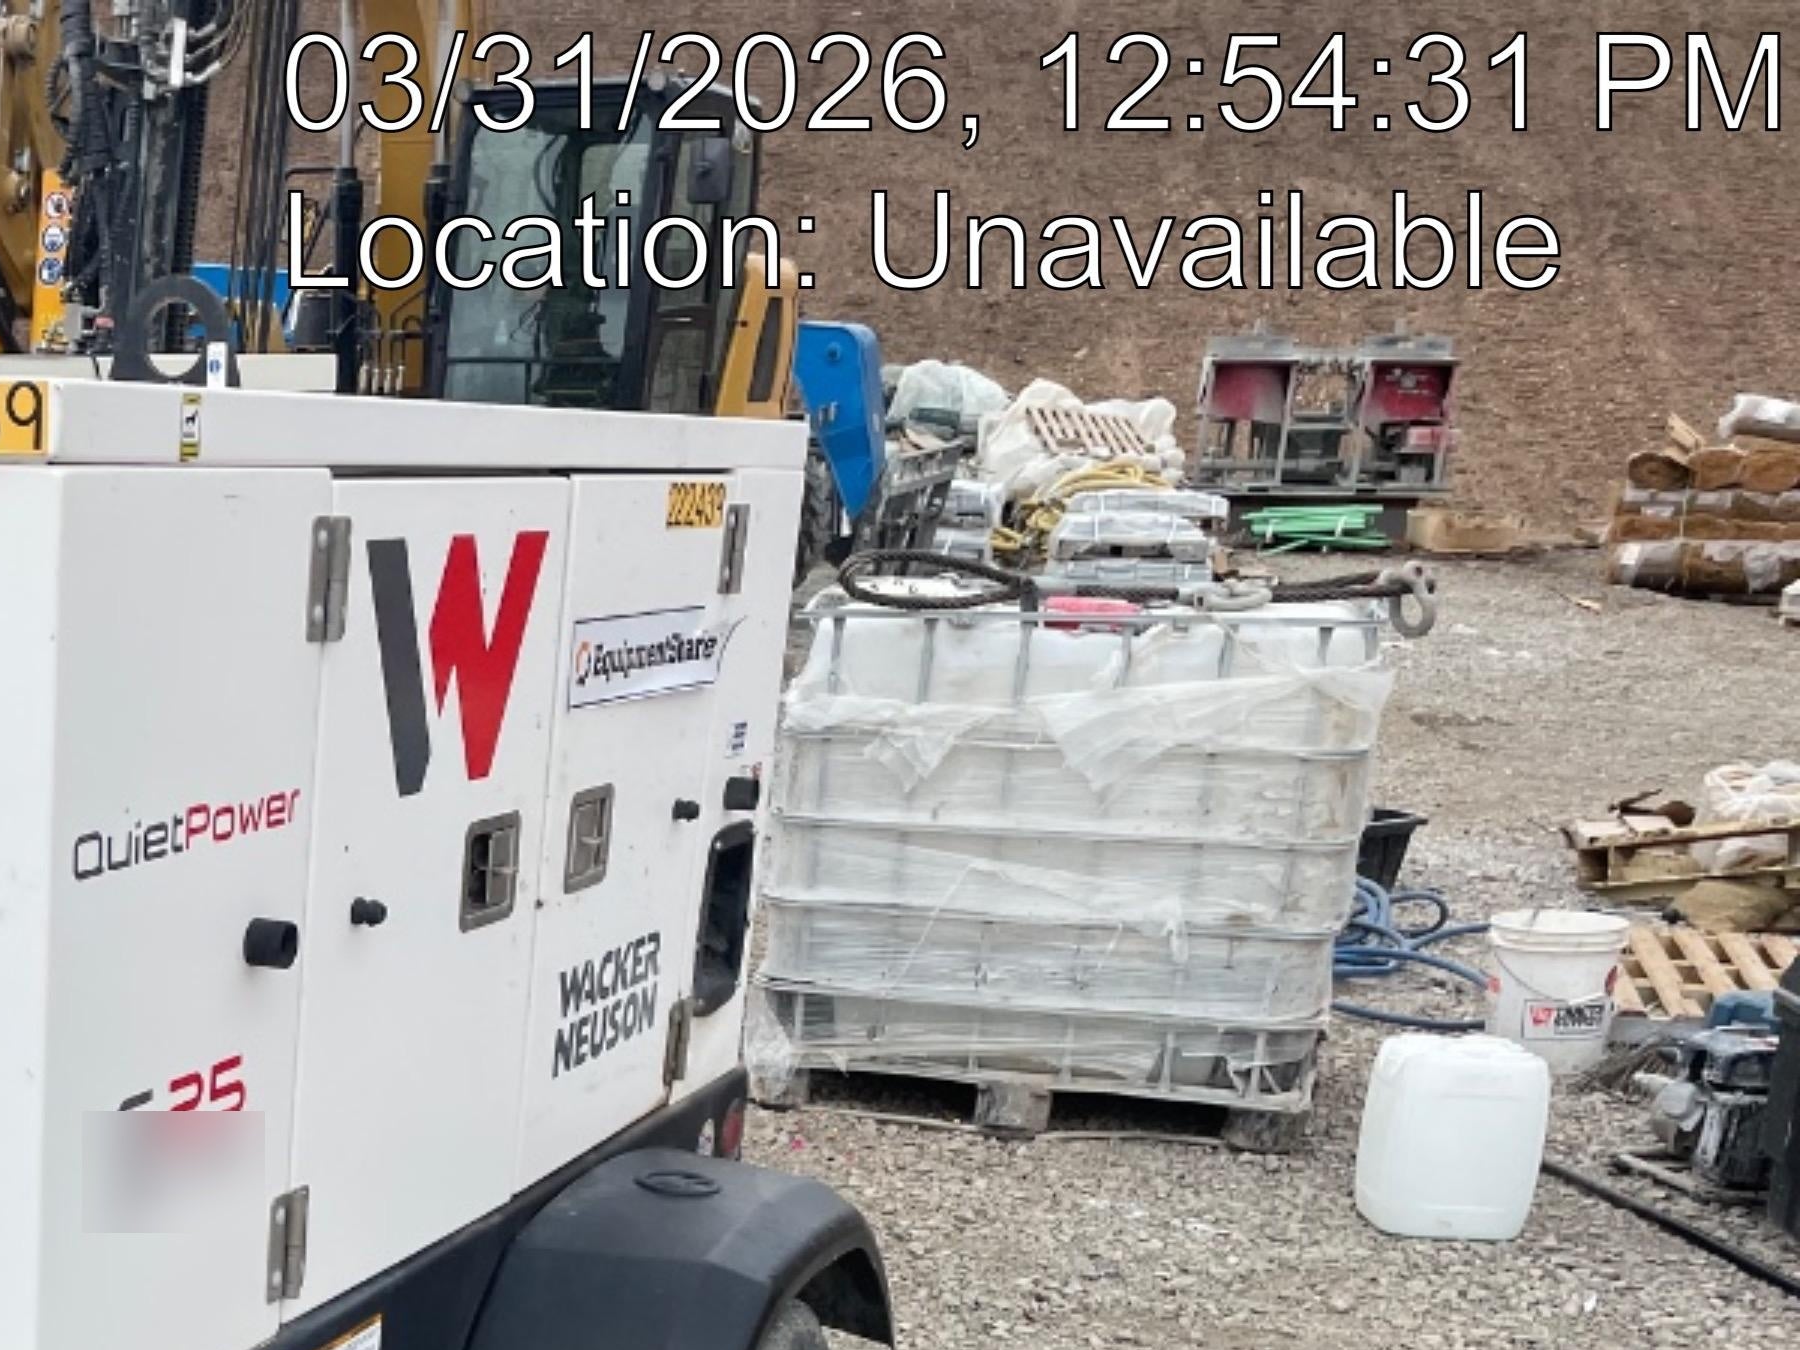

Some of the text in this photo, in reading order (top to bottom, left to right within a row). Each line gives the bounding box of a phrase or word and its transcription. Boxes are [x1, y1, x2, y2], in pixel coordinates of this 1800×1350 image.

[593, 631, 718, 683] EquipmentShare
[73, 788, 301, 881] QuietPower
[558, 930, 661, 1019] WACKER
[551, 980, 658, 1080] NEUSON
